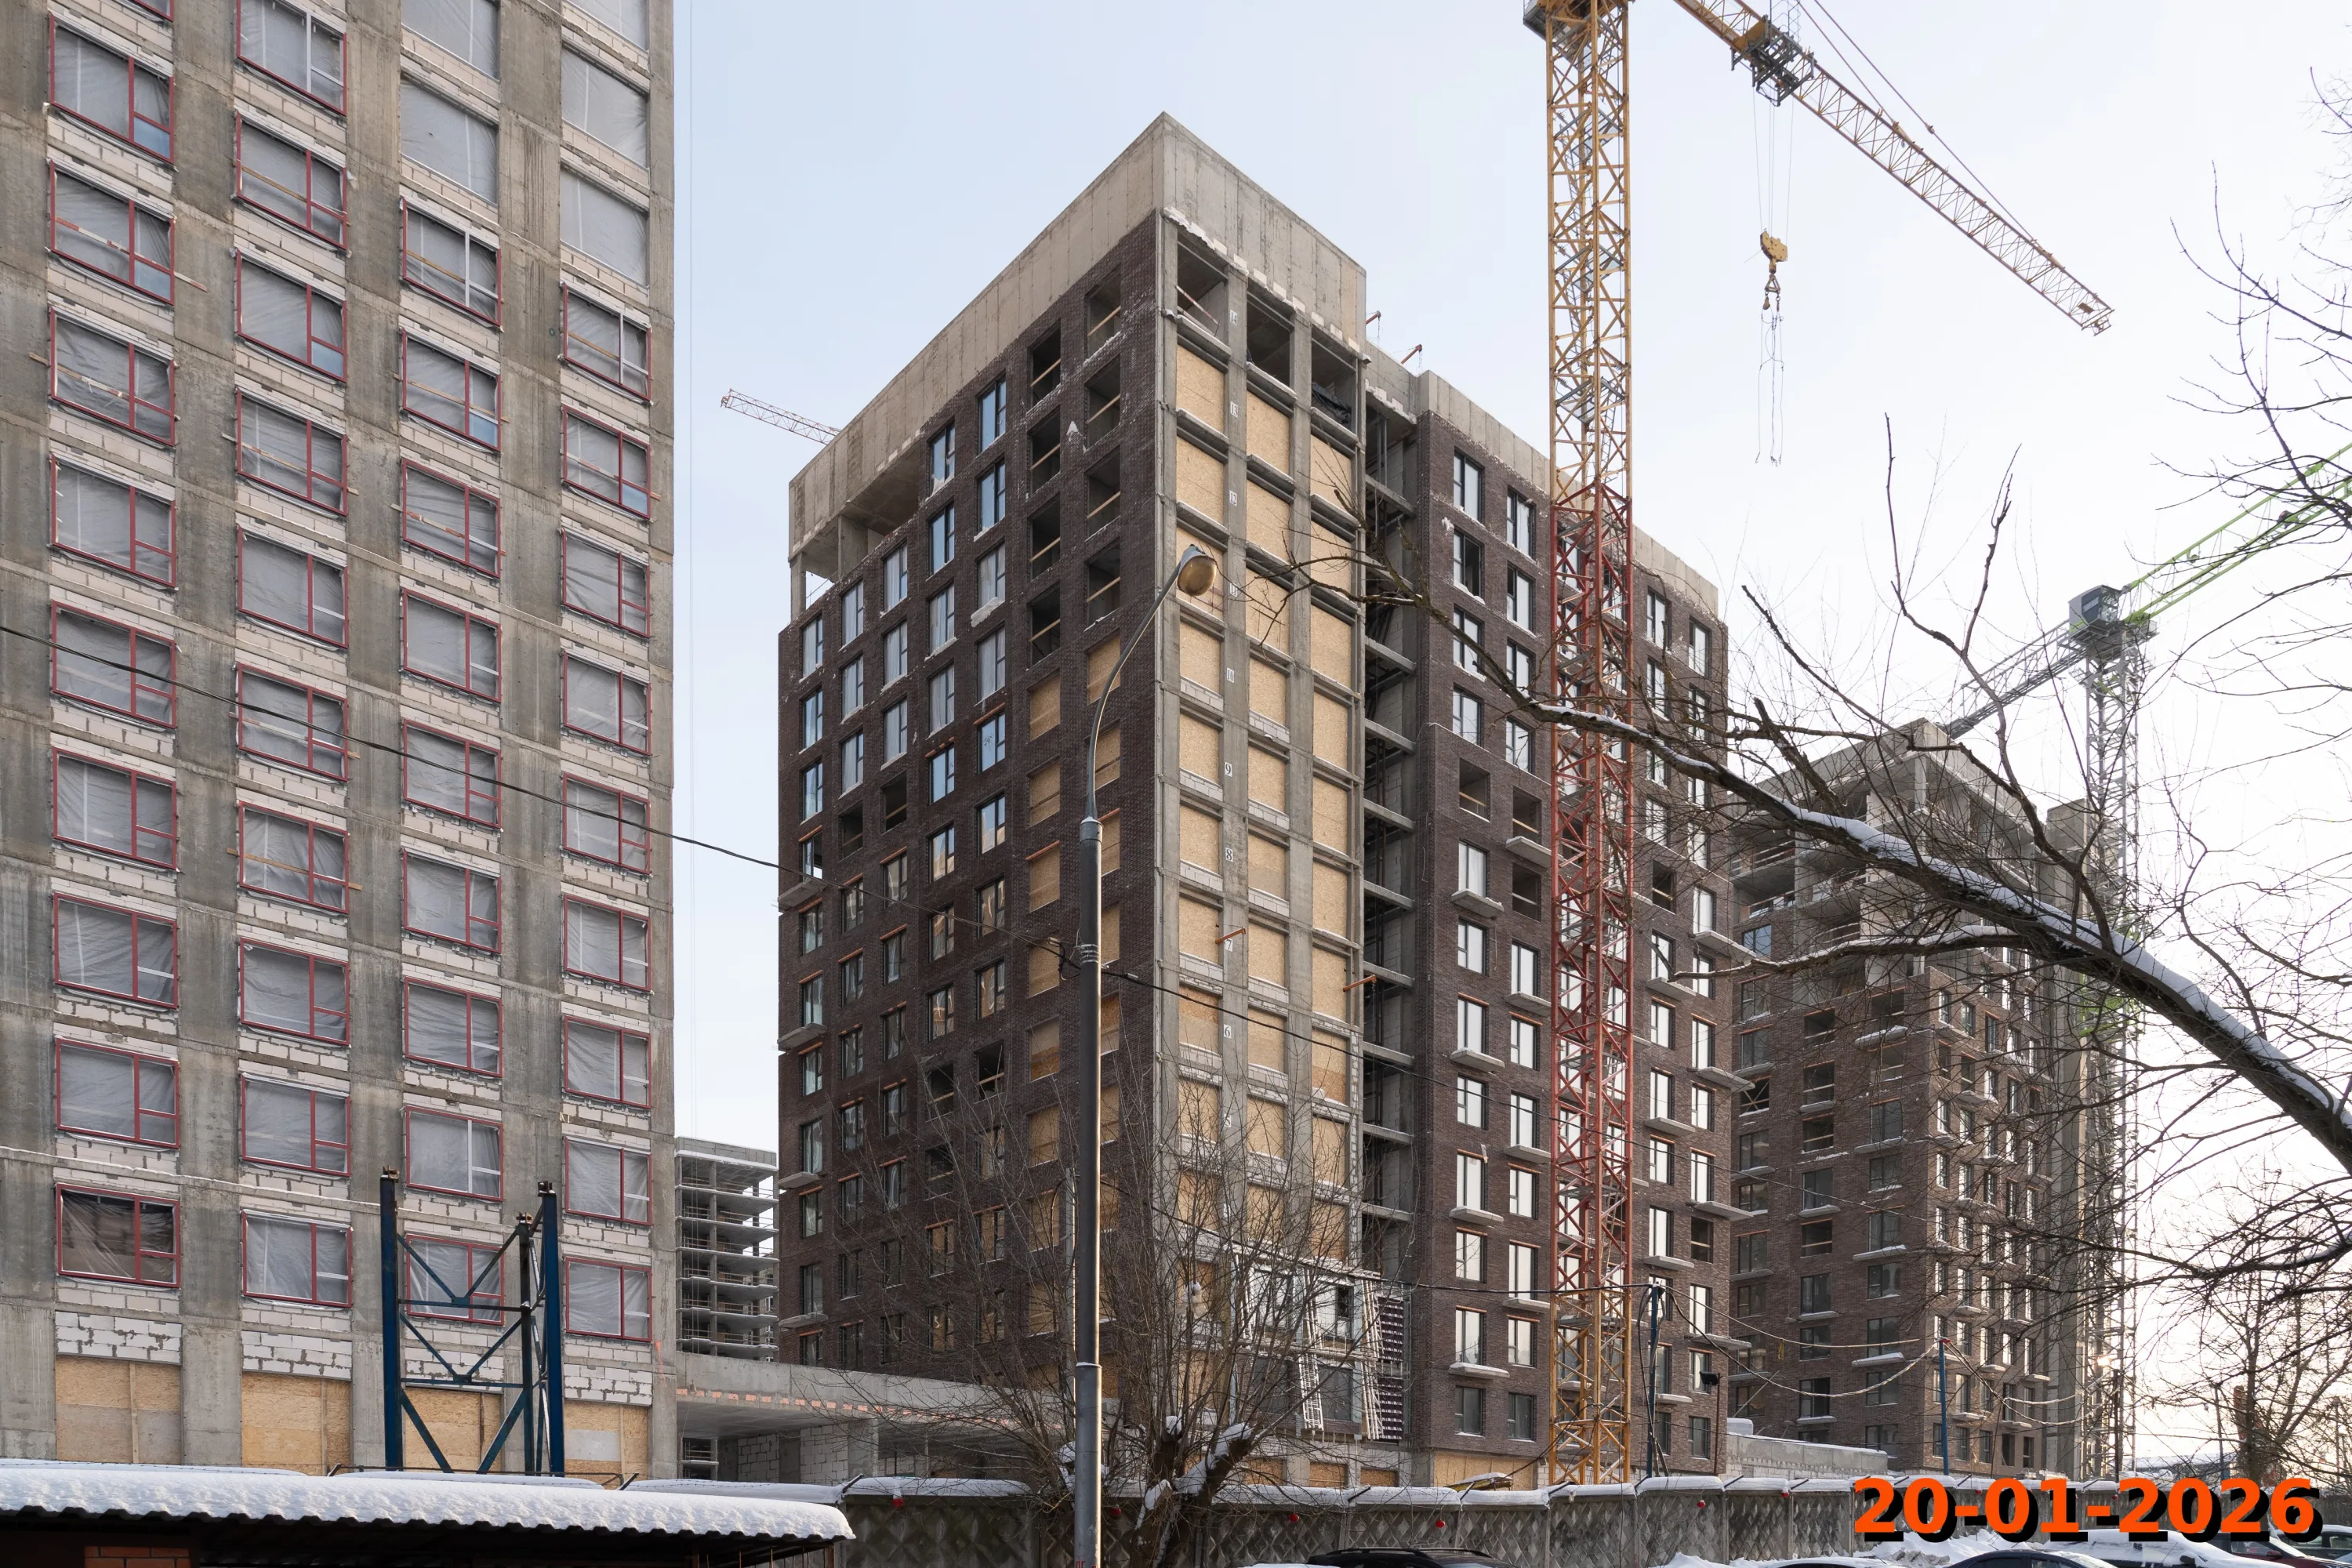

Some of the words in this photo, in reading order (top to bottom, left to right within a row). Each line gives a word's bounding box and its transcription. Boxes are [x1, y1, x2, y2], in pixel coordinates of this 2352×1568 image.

[1231, 311, 1237, 325] 14
[1231, 403, 1238, 416] 13
[1230, 492, 1236, 505] 12
[1227, 669, 1234, 681] 10
[1225, 763, 1232, 775] 9
[1226, 848, 1232, 861] 8
[1224, 1025, 1231, 1037] 6
